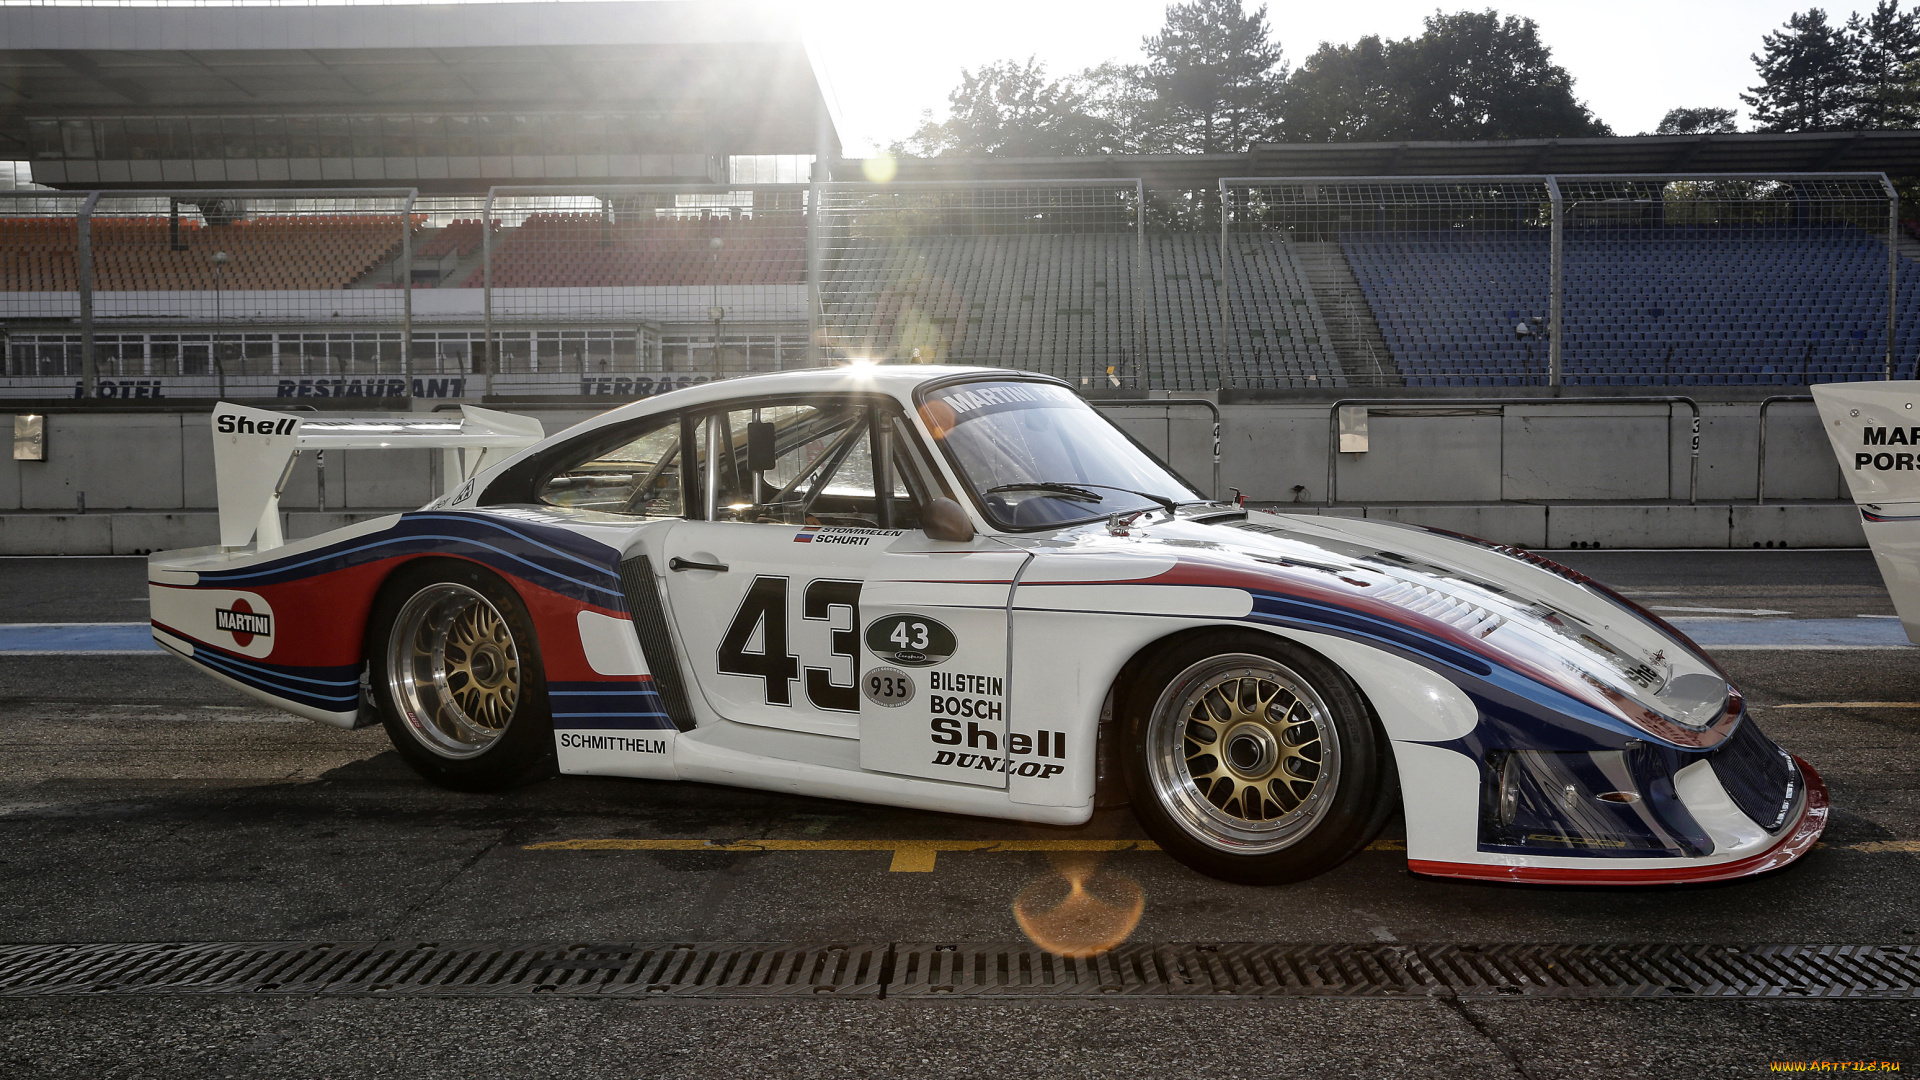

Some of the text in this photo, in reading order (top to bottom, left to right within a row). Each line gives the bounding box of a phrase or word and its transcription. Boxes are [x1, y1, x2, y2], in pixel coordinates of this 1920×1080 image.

[277, 378, 467, 398] RESTAURANT
[942, 386, 1037, 414] MARTINI
[217, 414, 297, 435] Shell
[1692, 419, 1700, 450] 39
[815, 534, 870, 546] SCHURTI
[822, 527, 903, 537] STOMMELEN
[218, 611, 268, 634] MARTINI
[890, 621, 929, 650] 43
[715, 573, 864, 714] 43
[870, 676, 907, 698] 935
[930, 671, 1003, 697] BILSTEIN
[930, 695, 1002, 721] BOSCH
[560, 733, 666, 755] SCHMITTHELM
[931, 717, 1066, 760] Shell
[931, 750, 1065, 779] DUNLOP
